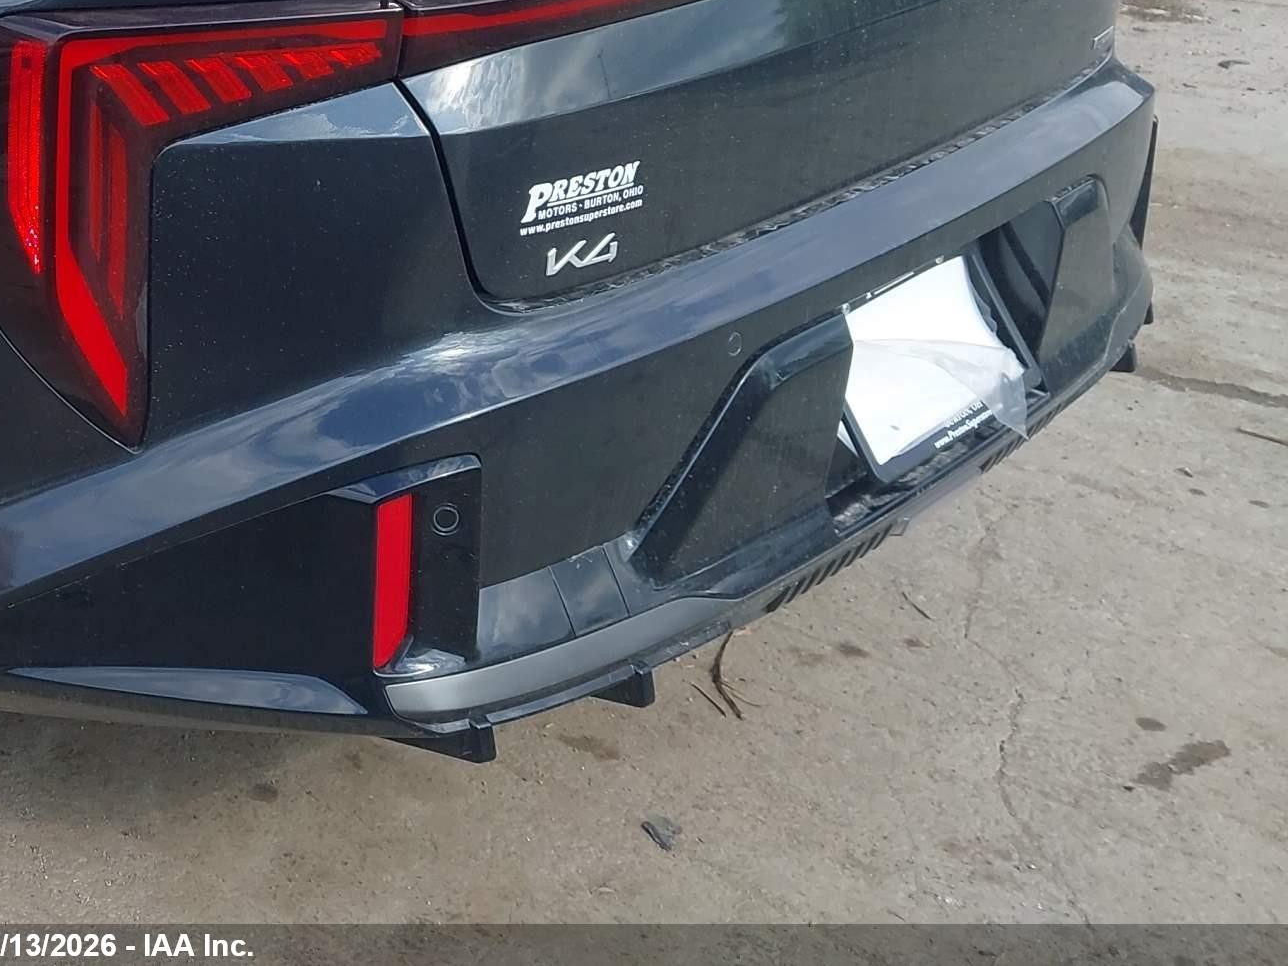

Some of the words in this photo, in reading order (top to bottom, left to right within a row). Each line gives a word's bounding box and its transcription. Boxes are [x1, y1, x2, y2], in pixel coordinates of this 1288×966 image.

[520, 161, 641, 224] PRESTON
[538, 202, 578, 220] MOTORS
[583, 191, 622, 210] BURTON,
[623, 185, 644, 199] OHIO
[520, 199, 643, 236] www.prestonsuperstore.com
[546, 233, 618, 276] K4
